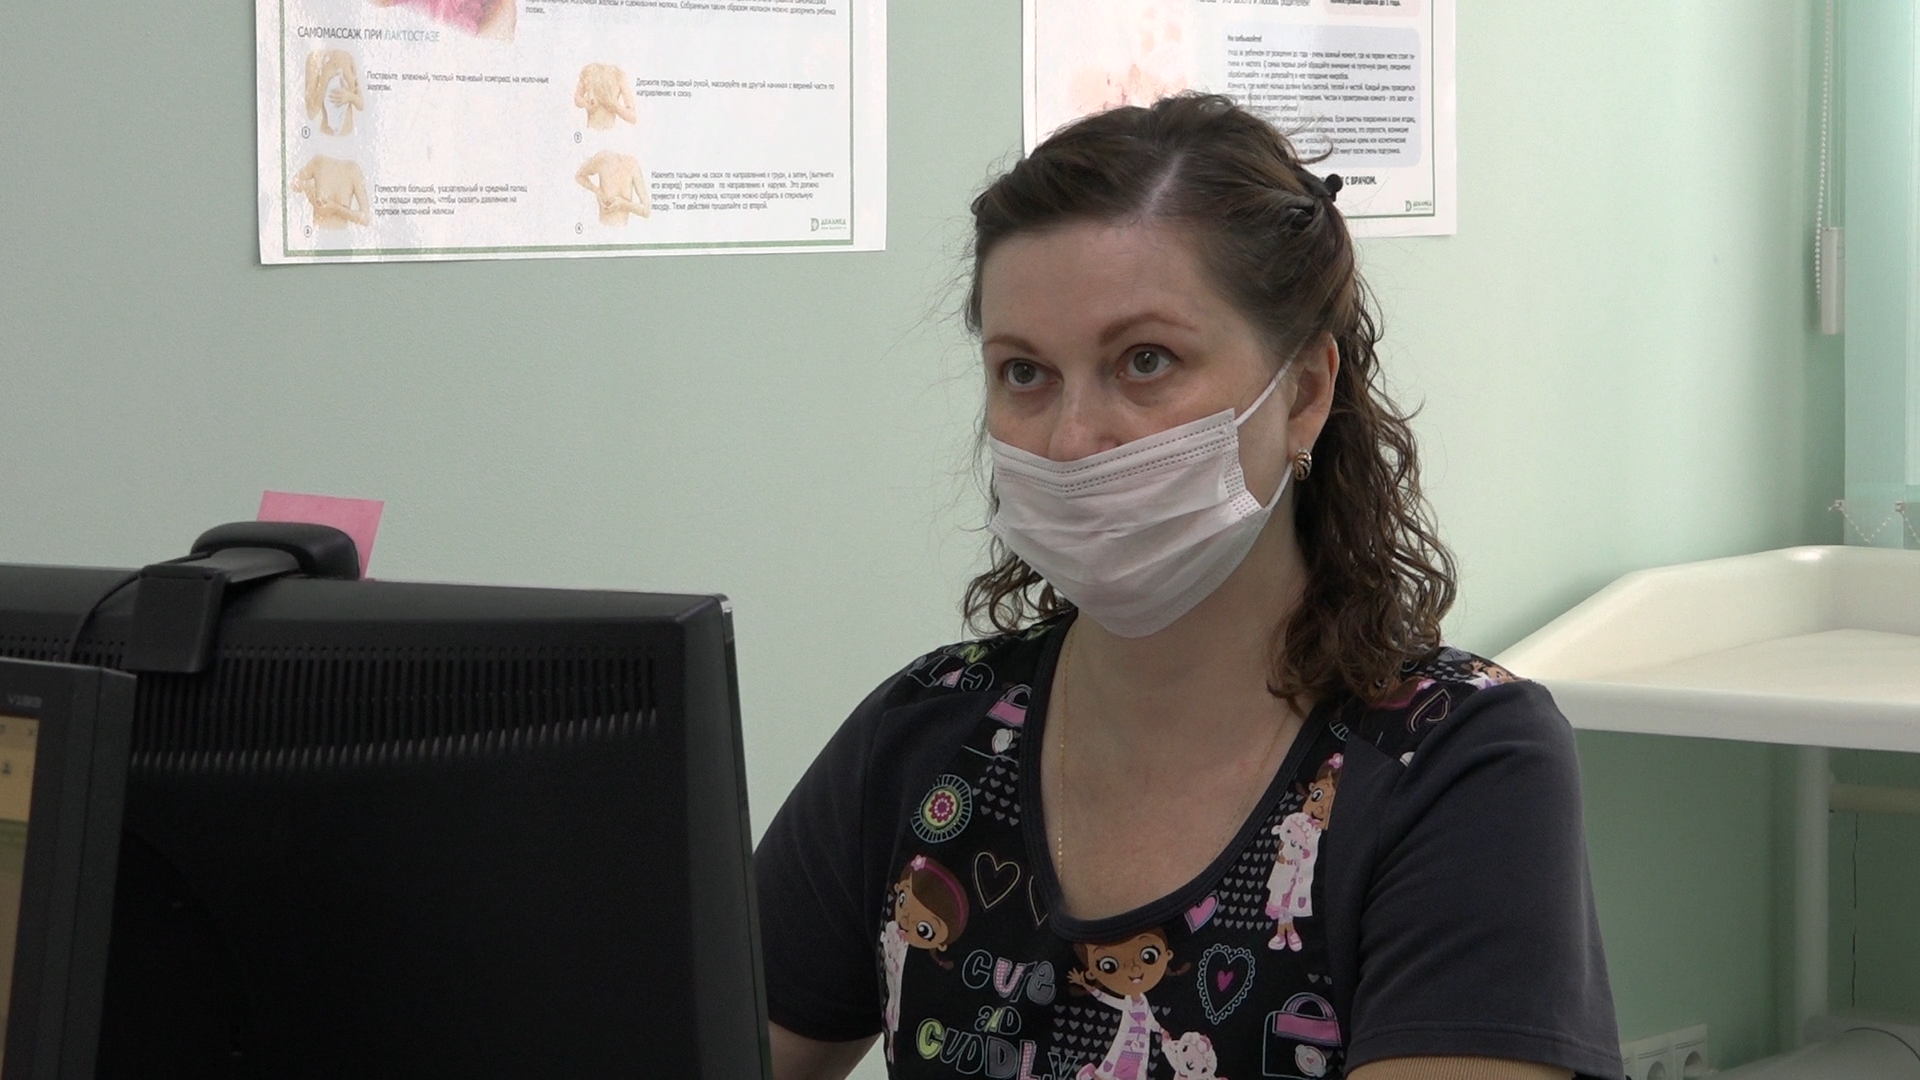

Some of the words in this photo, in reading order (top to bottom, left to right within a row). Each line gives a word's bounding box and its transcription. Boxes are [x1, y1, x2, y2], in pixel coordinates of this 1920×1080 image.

[298, 26, 361, 40] САМОМАССАЖ
[364, 29, 382, 40] ПРИ
[384, 30, 440, 42] ЛАКТОСТАЗЕ
[1345, 176, 1350, 186] С
[1351, 176, 1377, 186] ВРАЧОМ.
